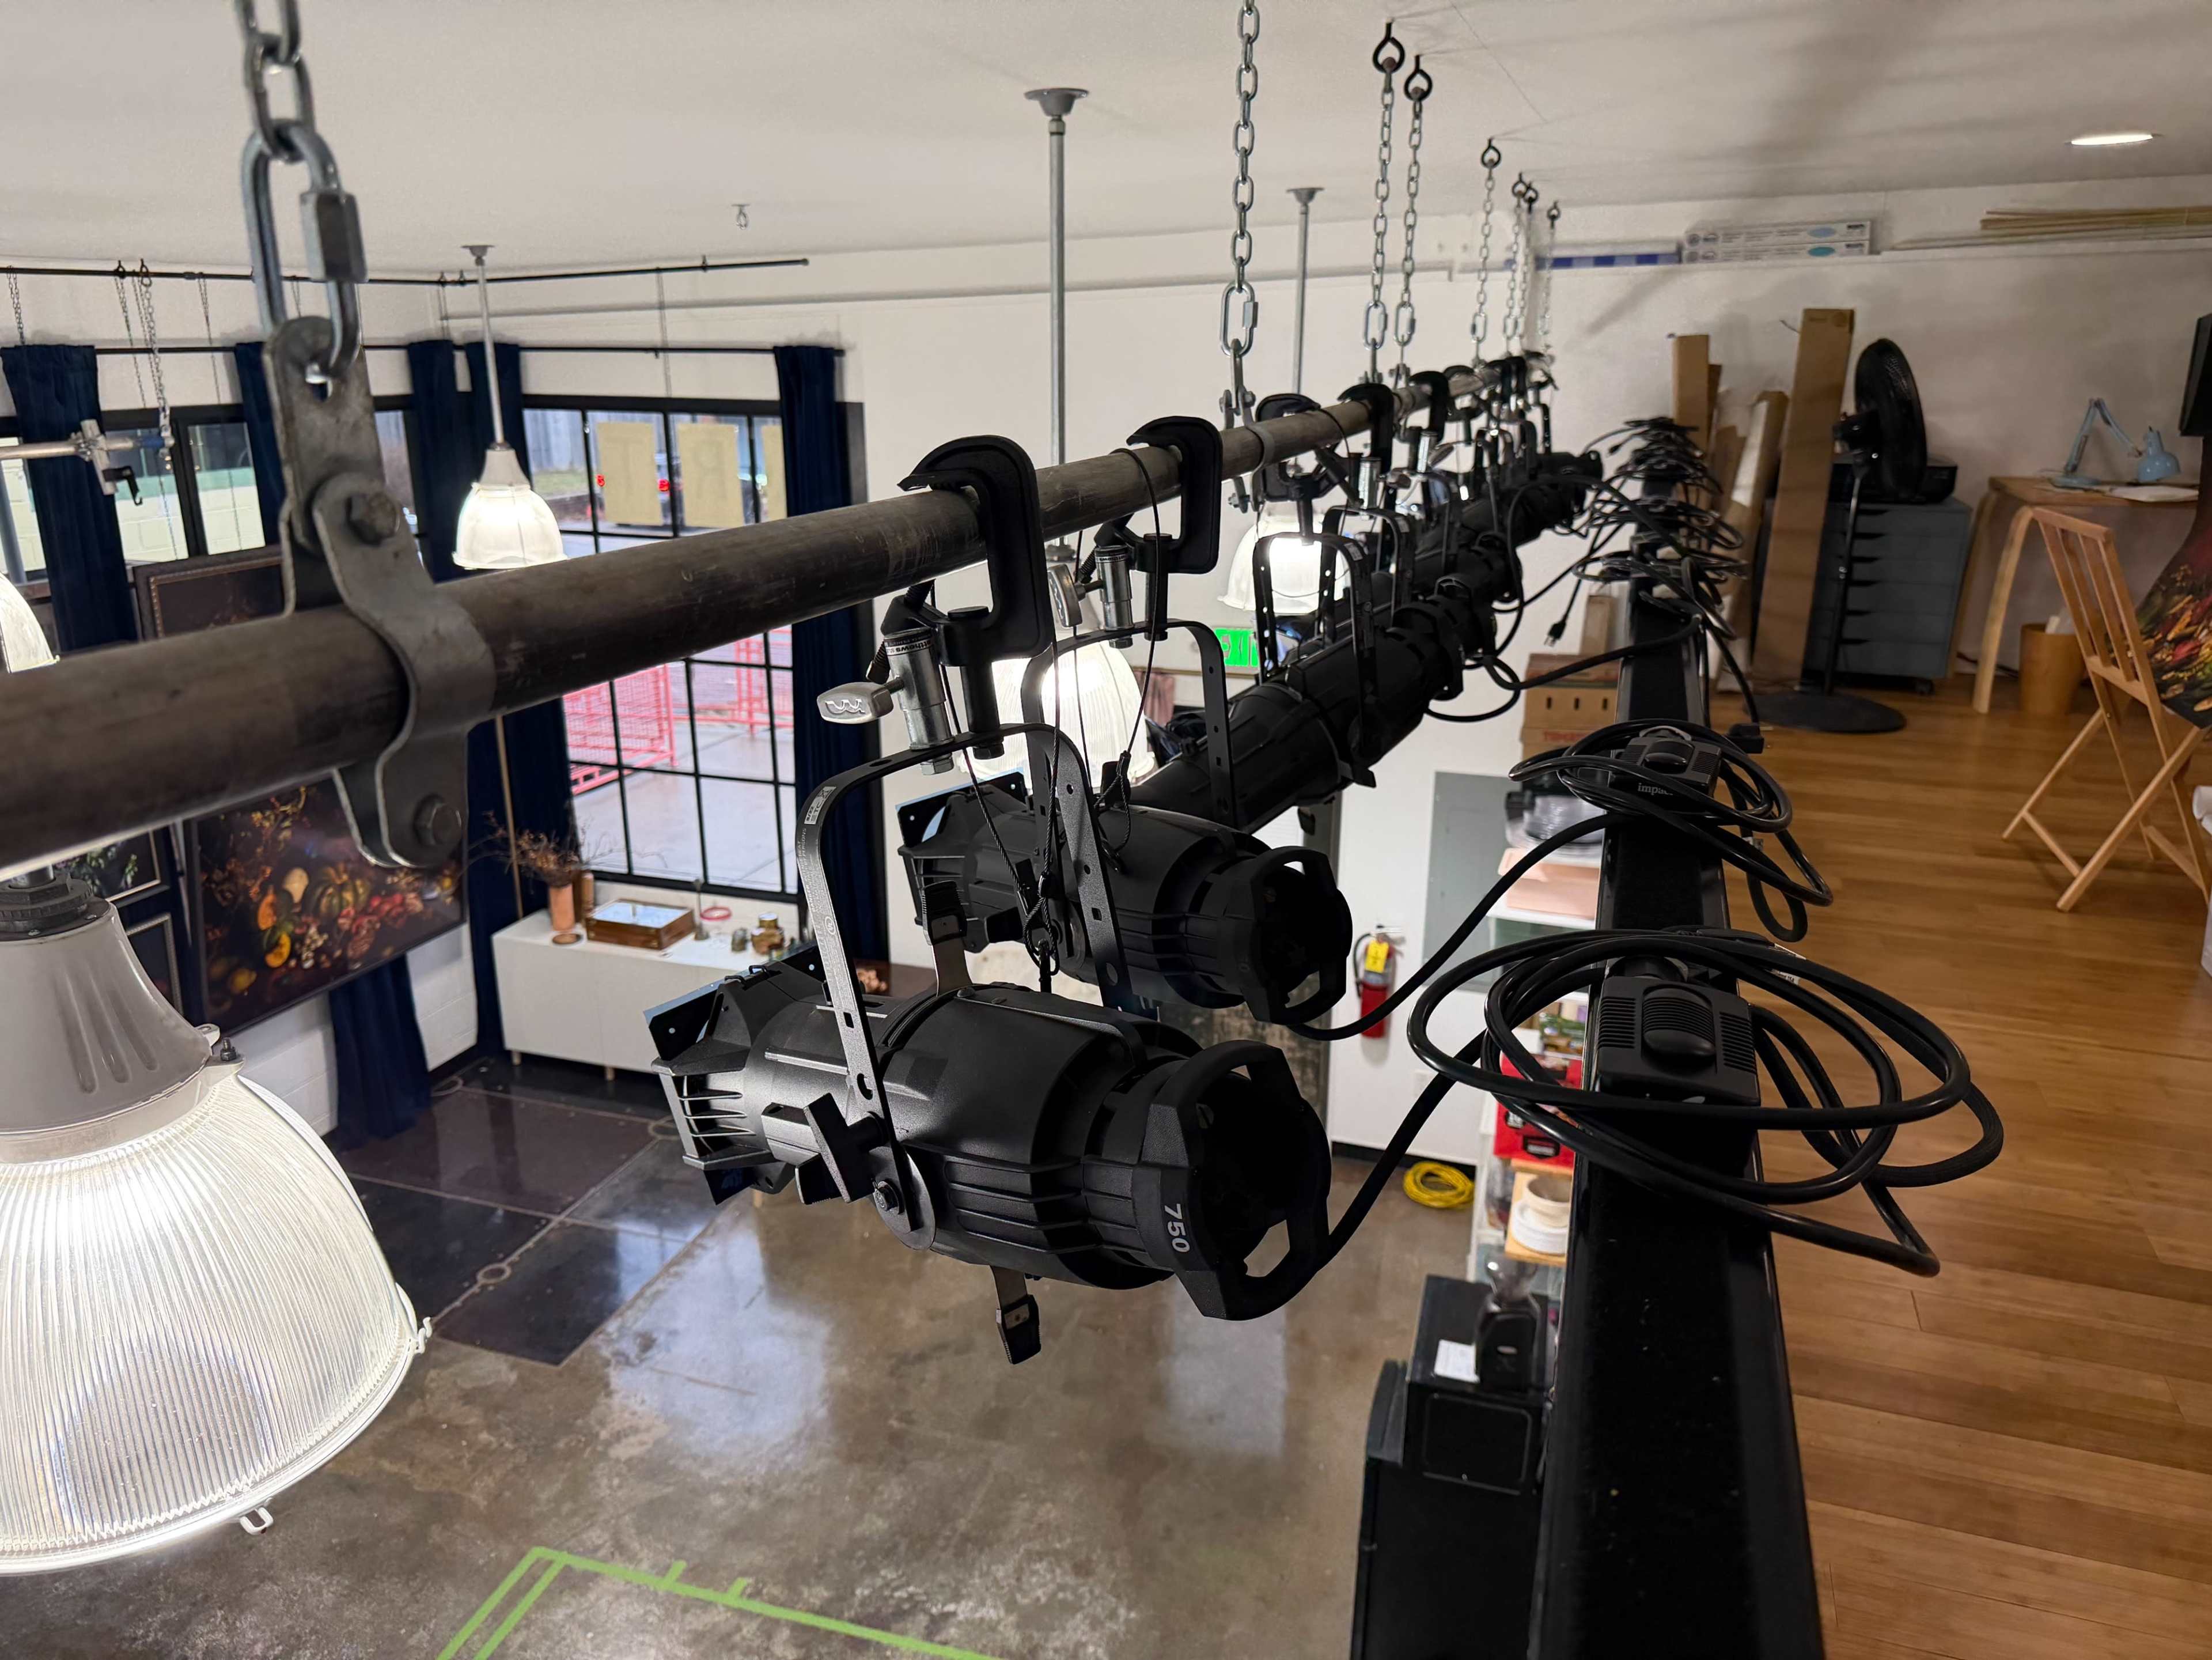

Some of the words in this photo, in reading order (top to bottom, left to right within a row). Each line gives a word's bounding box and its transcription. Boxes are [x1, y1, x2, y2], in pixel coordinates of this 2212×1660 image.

[896, 640, 931, 652] atthews
[1214, 628, 1260, 667] EXIT
[1637, 782, 1673, 796] impa
[1164, 1203, 1190, 1253] 750
